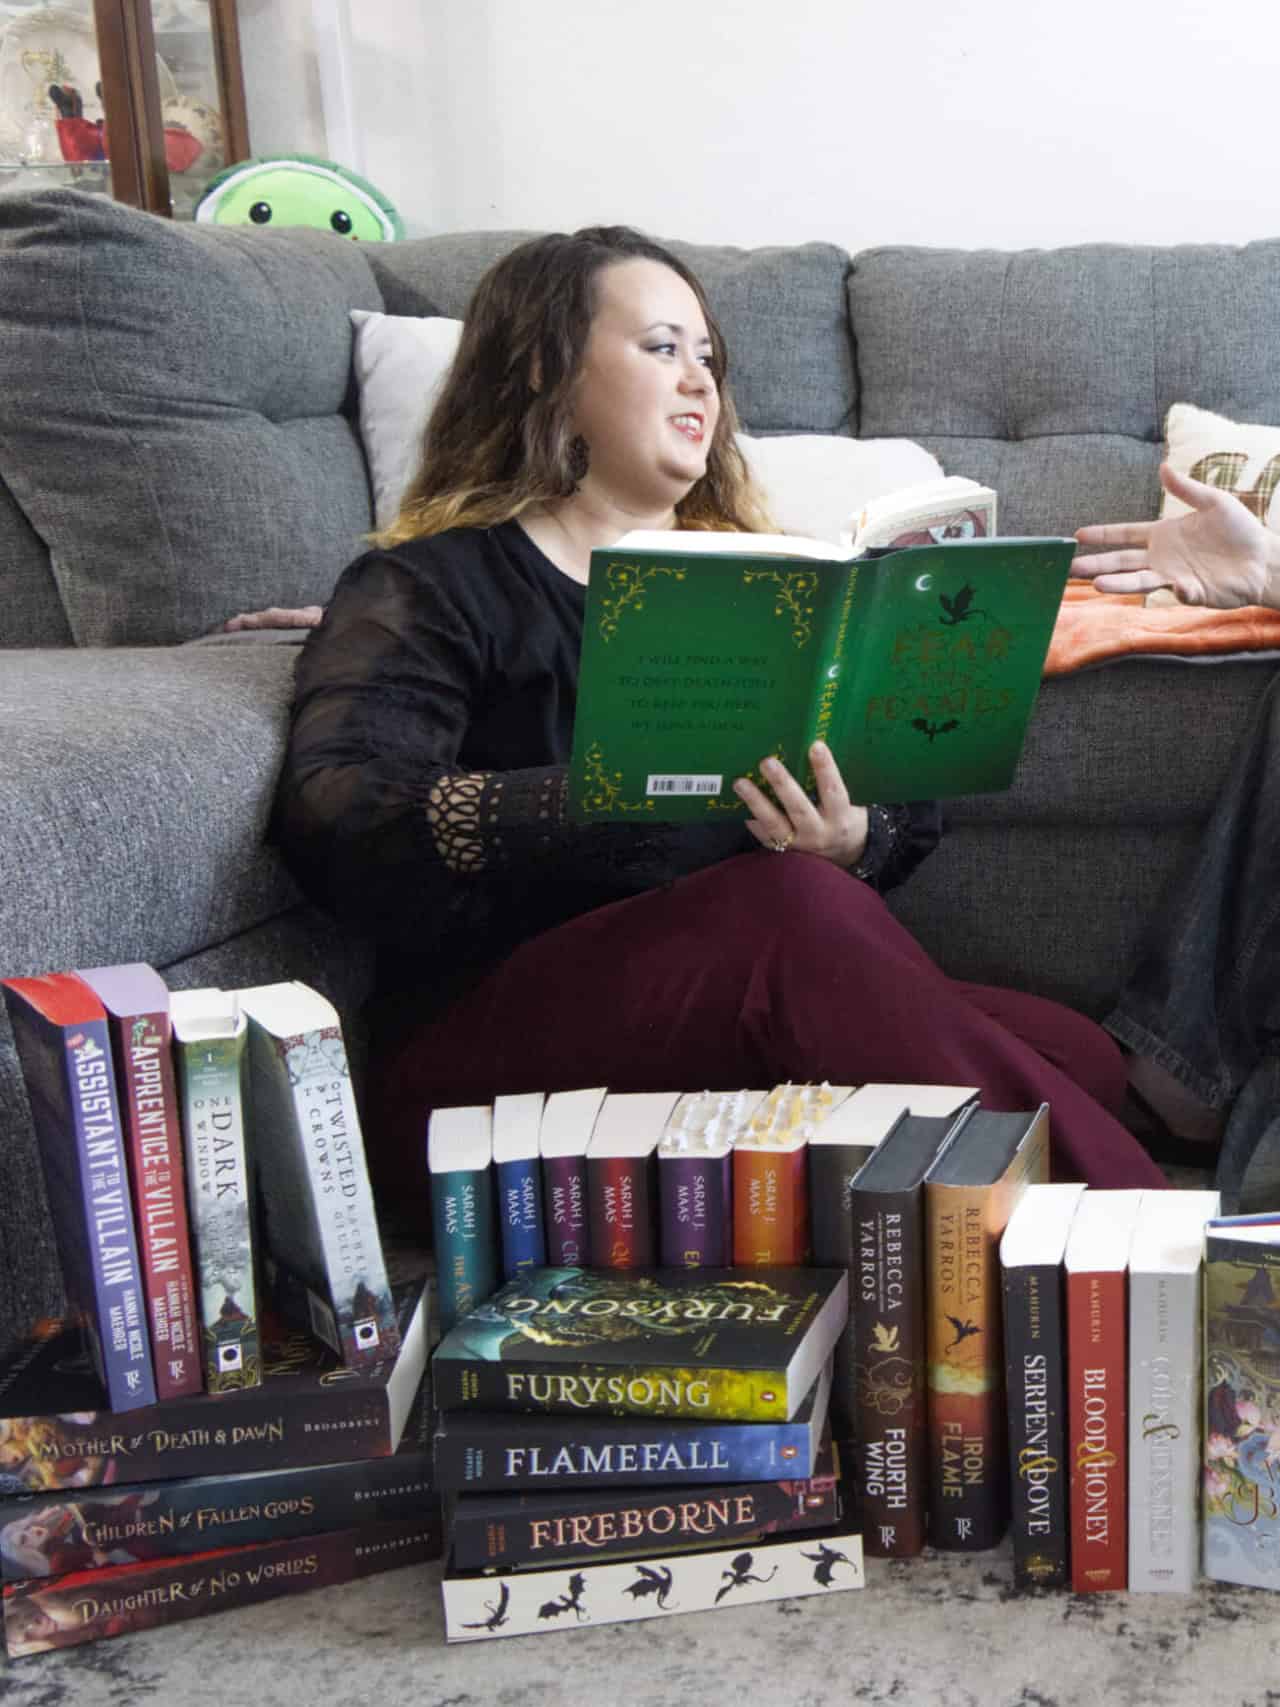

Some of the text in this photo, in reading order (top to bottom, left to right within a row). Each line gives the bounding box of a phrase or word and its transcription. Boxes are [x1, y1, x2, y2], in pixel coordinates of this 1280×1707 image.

[74, 1047, 120, 1170] ASSISTANT
[132, 1047, 170, 1168] APPRENTICE
[196, 1121, 211, 1194] WINDOW
[211, 1111, 239, 1200] DARK
[309, 1107, 337, 1195] CROWNS
[324, 1094, 358, 1200] TWISTED
[445, 1196, 459, 1235] MAAS
[461, 1184, 476, 1228] SARAH
[506, 1188, 521, 1226] MAAS
[521, 1176, 536, 1219] SARAH
[551, 1186, 566, 1225] MAAS
[567, 1175, 583, 1218] SARAH
[603, 1186, 617, 1223] MAAS
[619, 1175, 633, 1219] SARAH
[676, 1185, 689, 1223] MAAS
[693, 1175, 706, 1218] SARAH
[749, 1178, 761, 1215] MAAS
[764, 1168, 777, 1212] SARAH
[92, 1188, 134, 1287] VILLAIN
[144, 1185, 180, 1273] VILLAIN
[940, 1213, 955, 1296] YARROS
[964, 1206, 982, 1305] REBECCA
[860, 1220, 876, 1302] YARROS
[886, 1213, 902, 1312] REBECCA
[505, 1298, 790, 1321] FURYSONG
[1028, 1275, 1041, 1341] MAHURIN
[1089, 1278, 1102, 1344] MAHURIN
[506, 1373, 712, 1408] FURYSONG
[1023, 1354, 1051, 1452] SERPENT
[1083, 1367, 1107, 1452] BLOOD
[38, 1417, 285, 1460] MOTHER DEATH & DAWN
[303, 1417, 381, 1434] BROADBENT
[504, 1440, 730, 1477] FLAMEFALL
[864, 1441, 884, 1497] WING
[884, 1427, 908, 1510] FOURTH
[940, 1420, 964, 1498] FLAME
[962, 1435, 984, 1486] IRON
[353, 1482, 431, 1502] BROADBENT
[1025, 1460, 1051, 1537] DOVE
[1084, 1460, 1109, 1546] HONEY
[81, 1495, 315, 1548] CHILDREN FALLEN GODS
[354, 1532, 432, 1558] BROADBENT
[529, 1494, 757, 1550] FIREBORNE
[71, 1554, 319, 1624] DAUGHTER NO WORLDS
